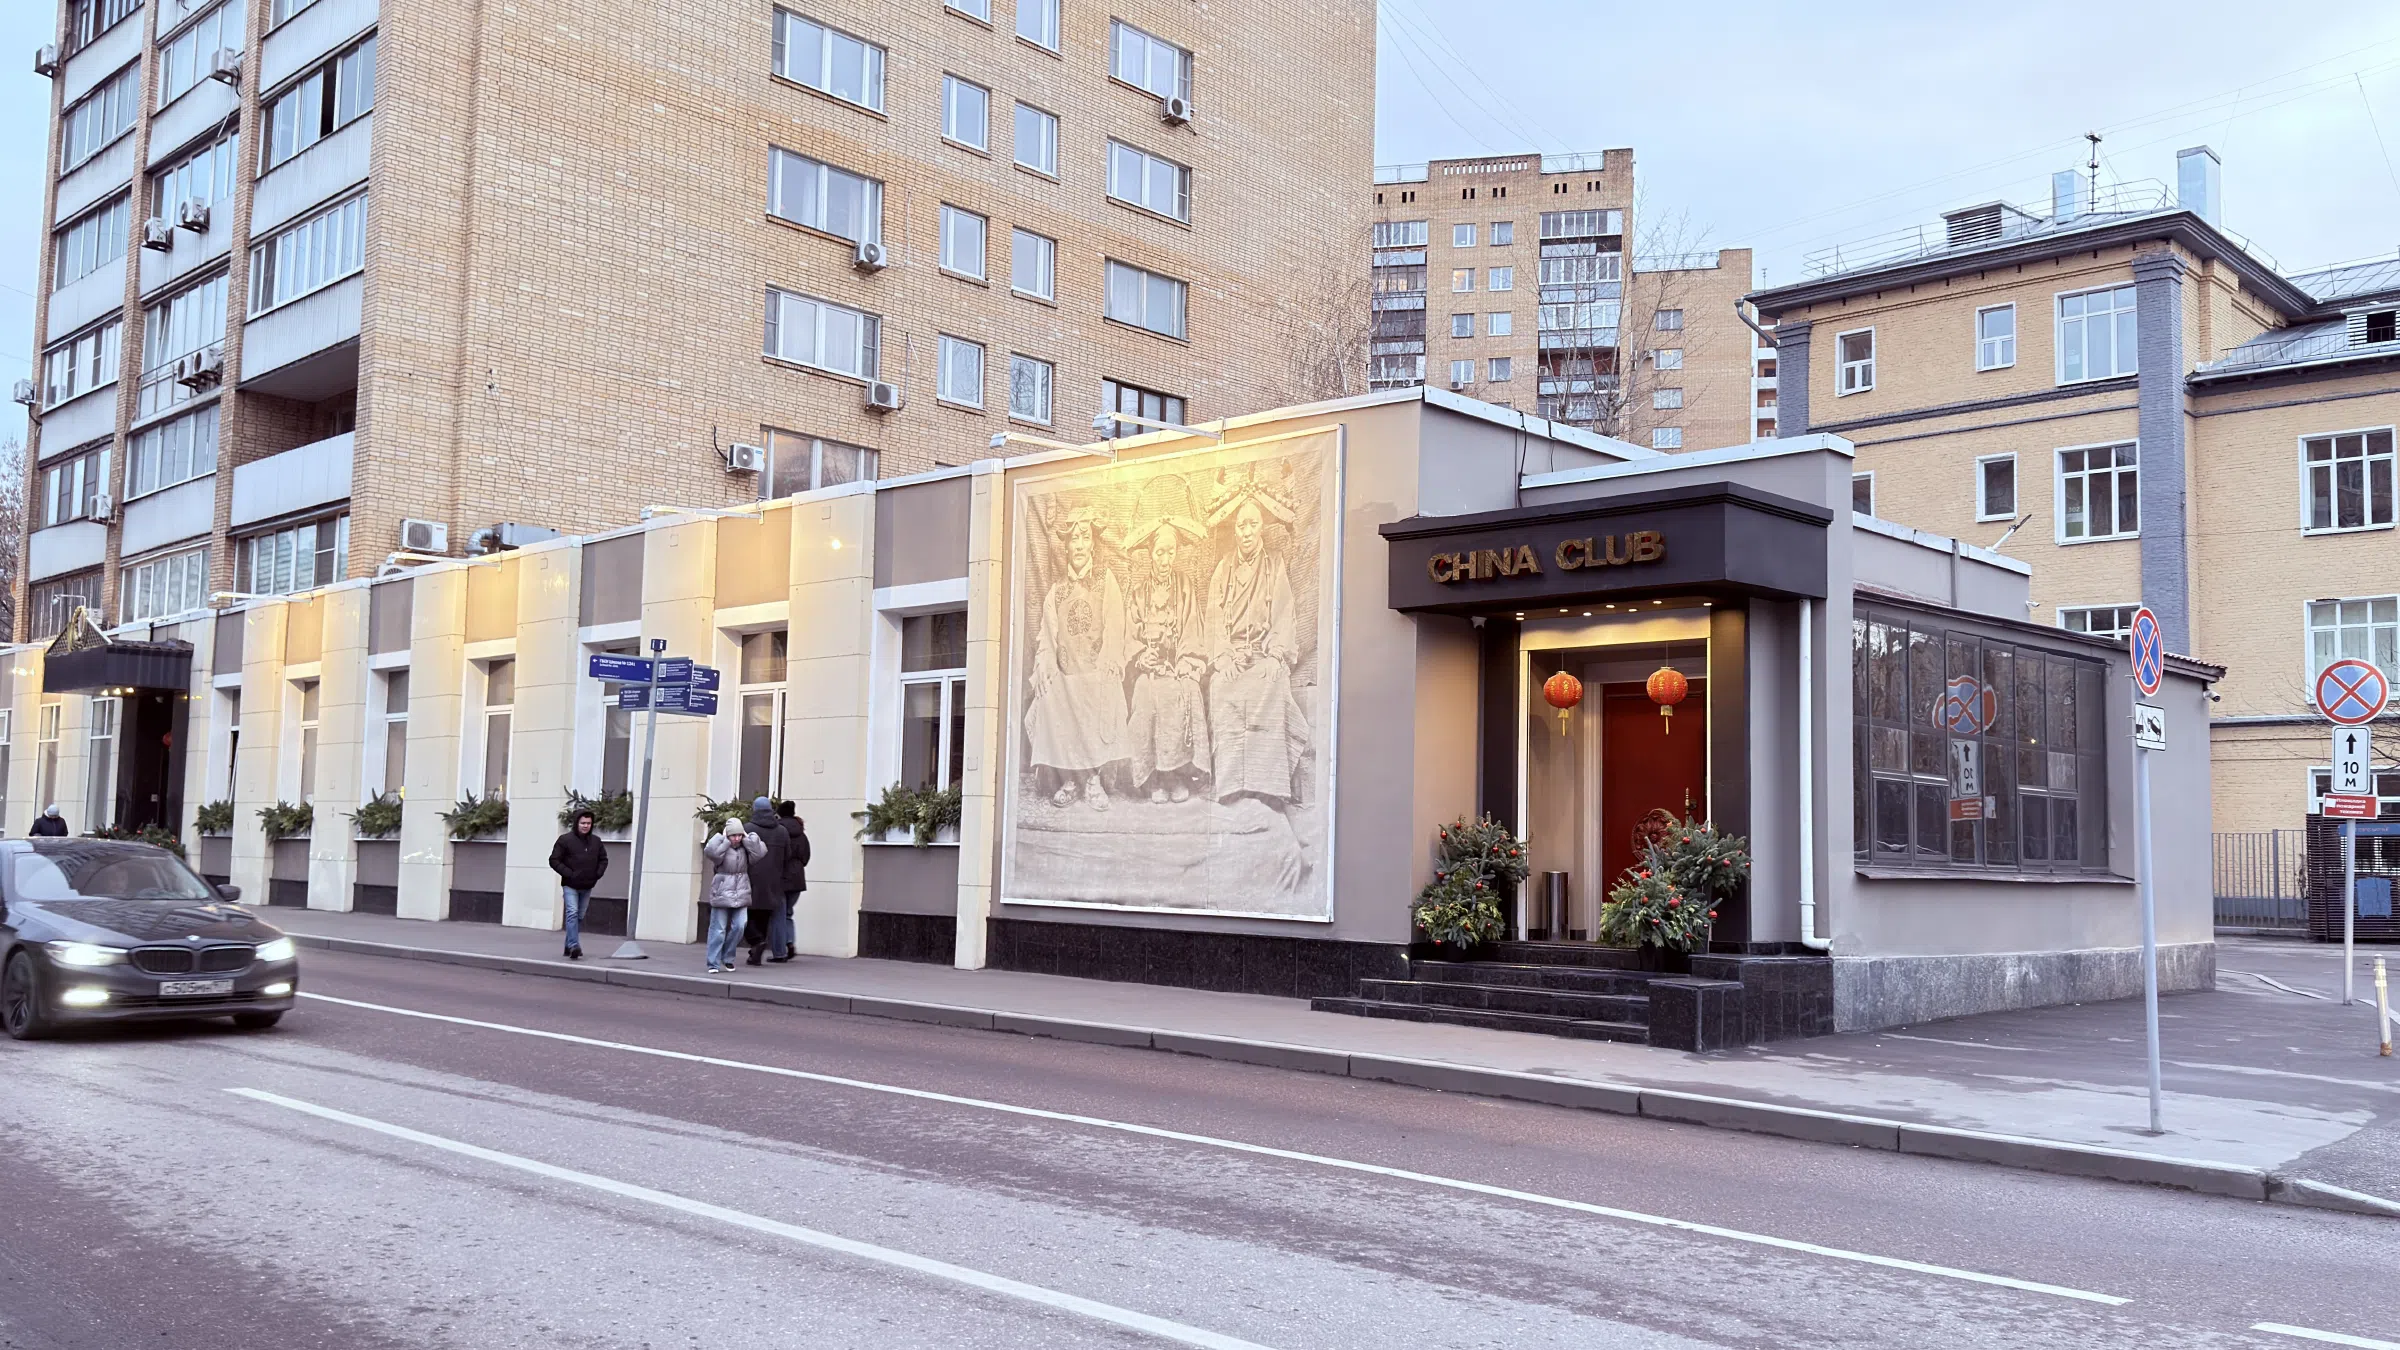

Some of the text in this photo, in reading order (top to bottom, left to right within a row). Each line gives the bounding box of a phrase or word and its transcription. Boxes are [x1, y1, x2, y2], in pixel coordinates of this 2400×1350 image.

[1427, 530, 1666, 583] CHINA CLUB
[2343, 761, 2359, 774] 10
